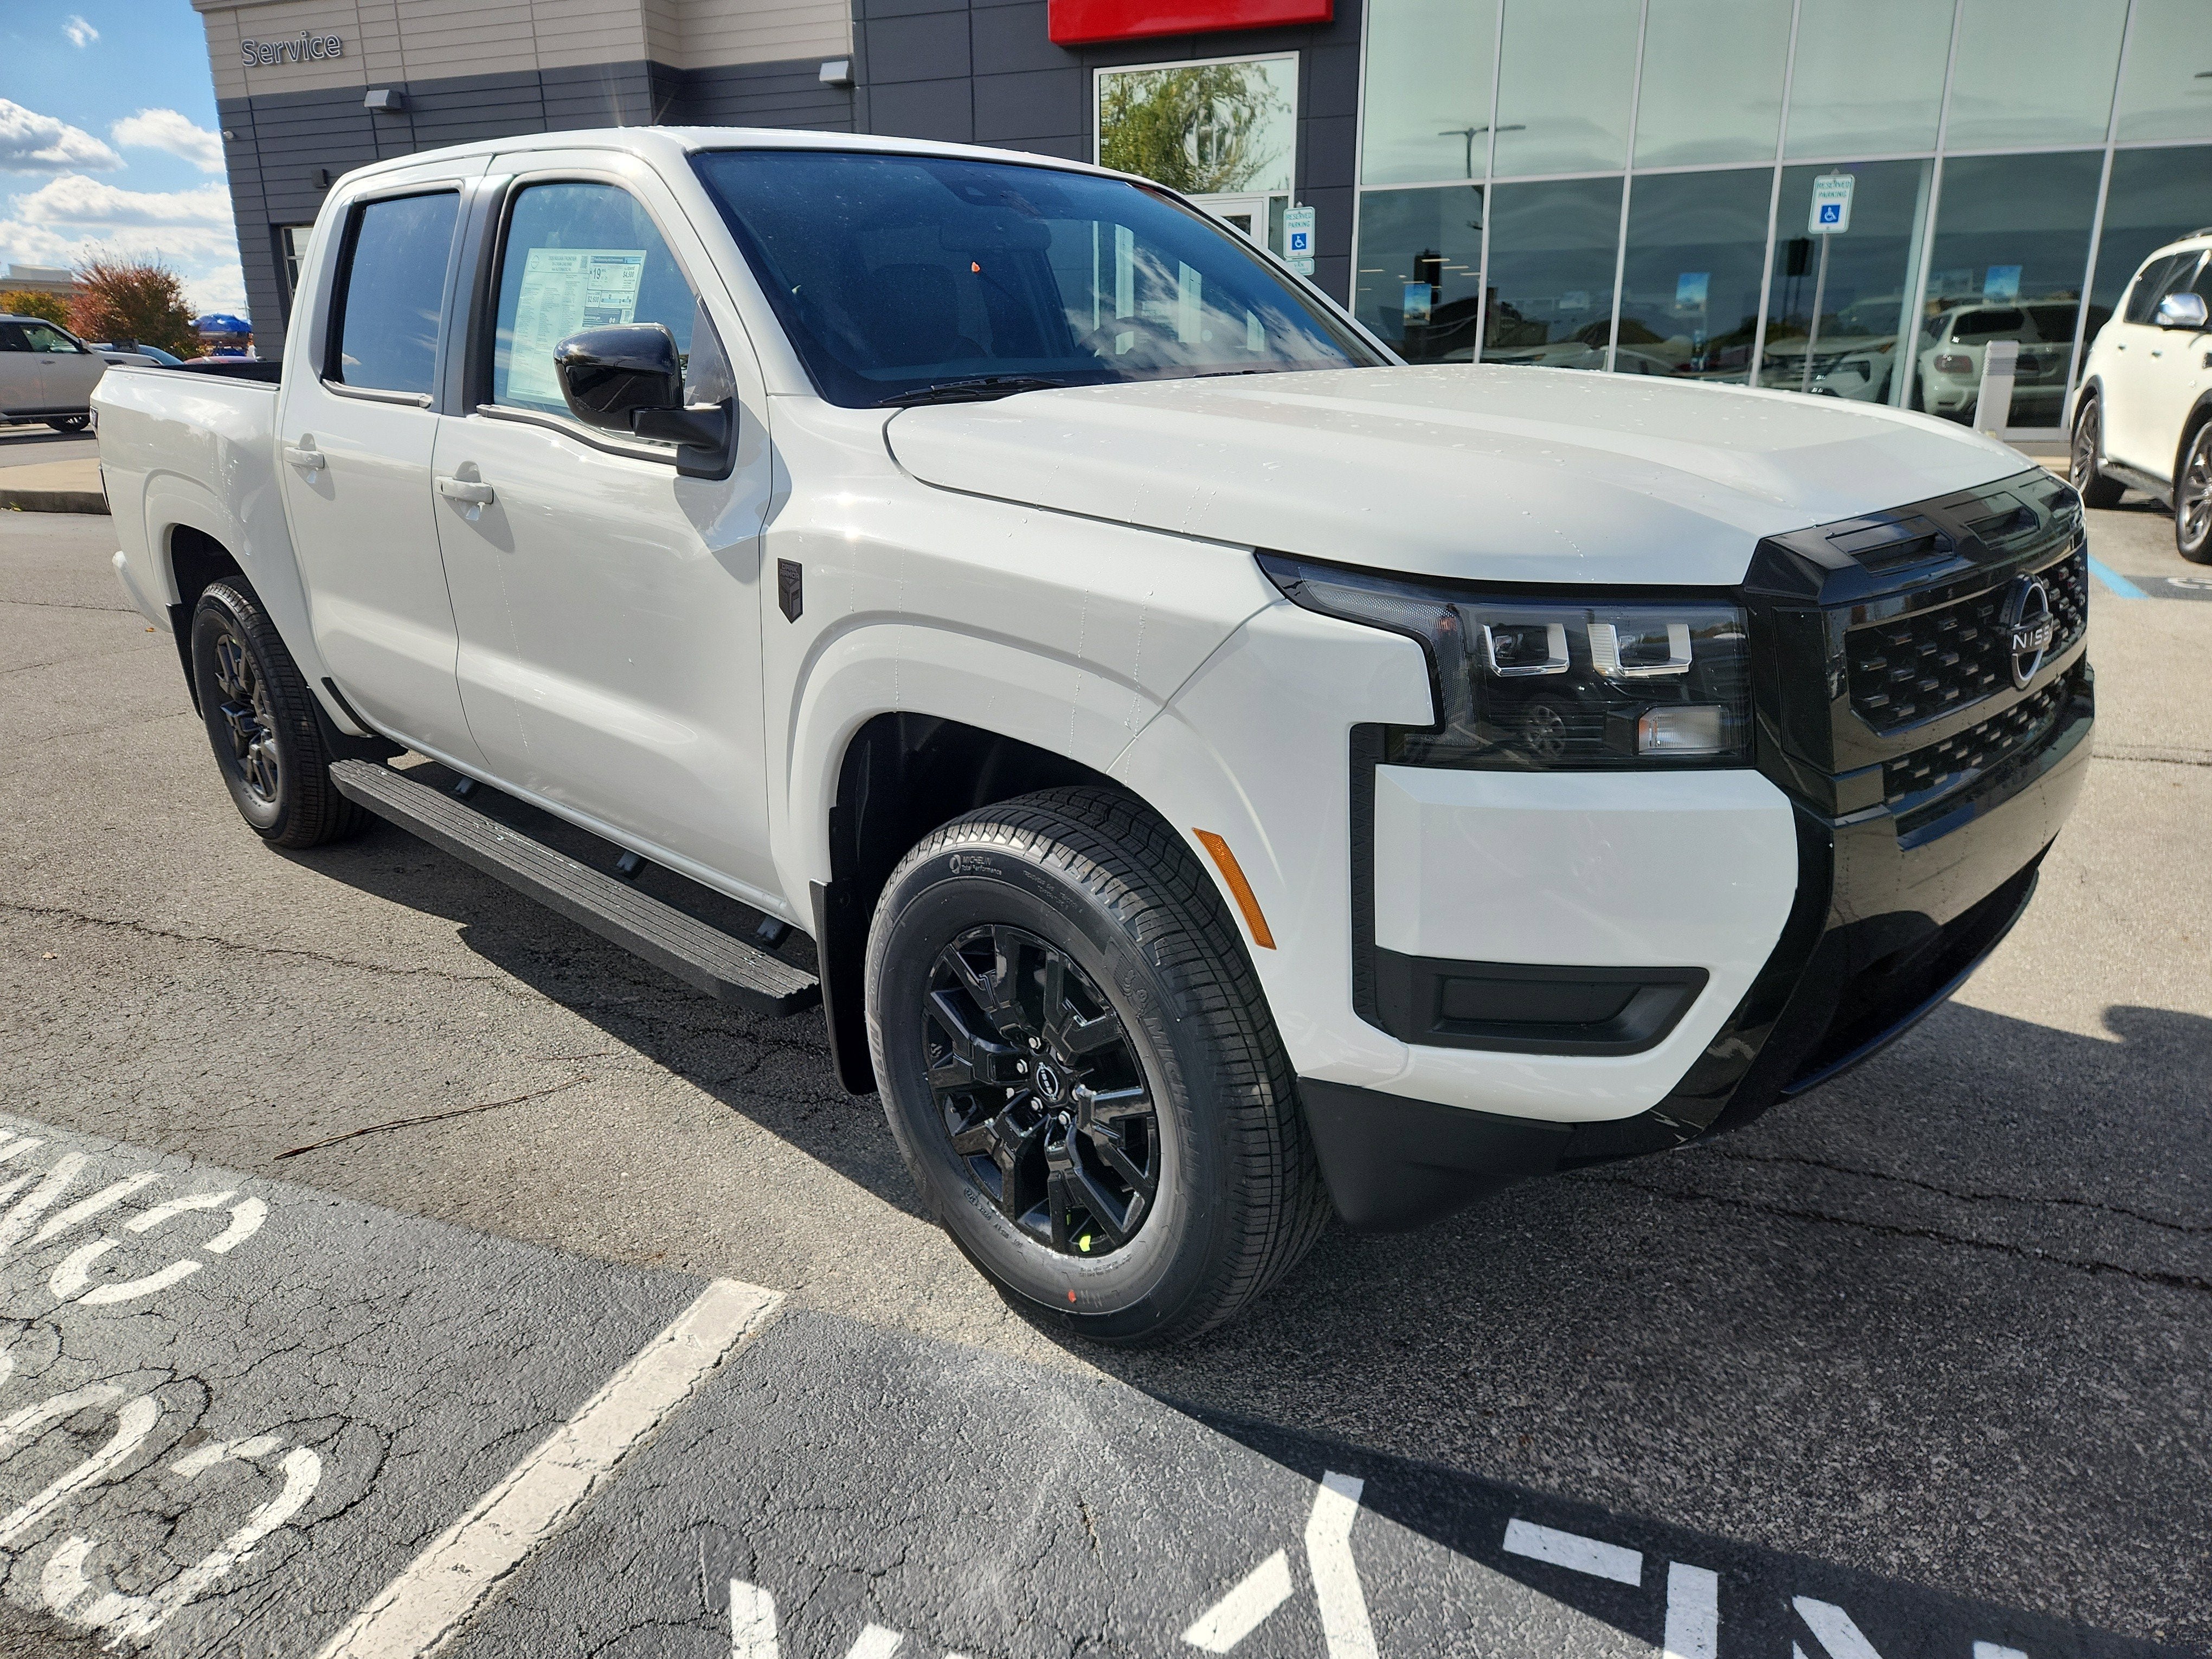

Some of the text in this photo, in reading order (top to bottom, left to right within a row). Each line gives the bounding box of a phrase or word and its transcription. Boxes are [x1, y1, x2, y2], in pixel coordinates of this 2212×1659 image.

[241, 30, 341, 66] Service
[593, 268, 601, 280] 19
[2012, 624, 2051, 650] NISS
[962, 856, 992, 865] MICHELIN
[972, 865, 1002, 876] Performance
[1143, 1017, 1200, 1179] MICHELIN
